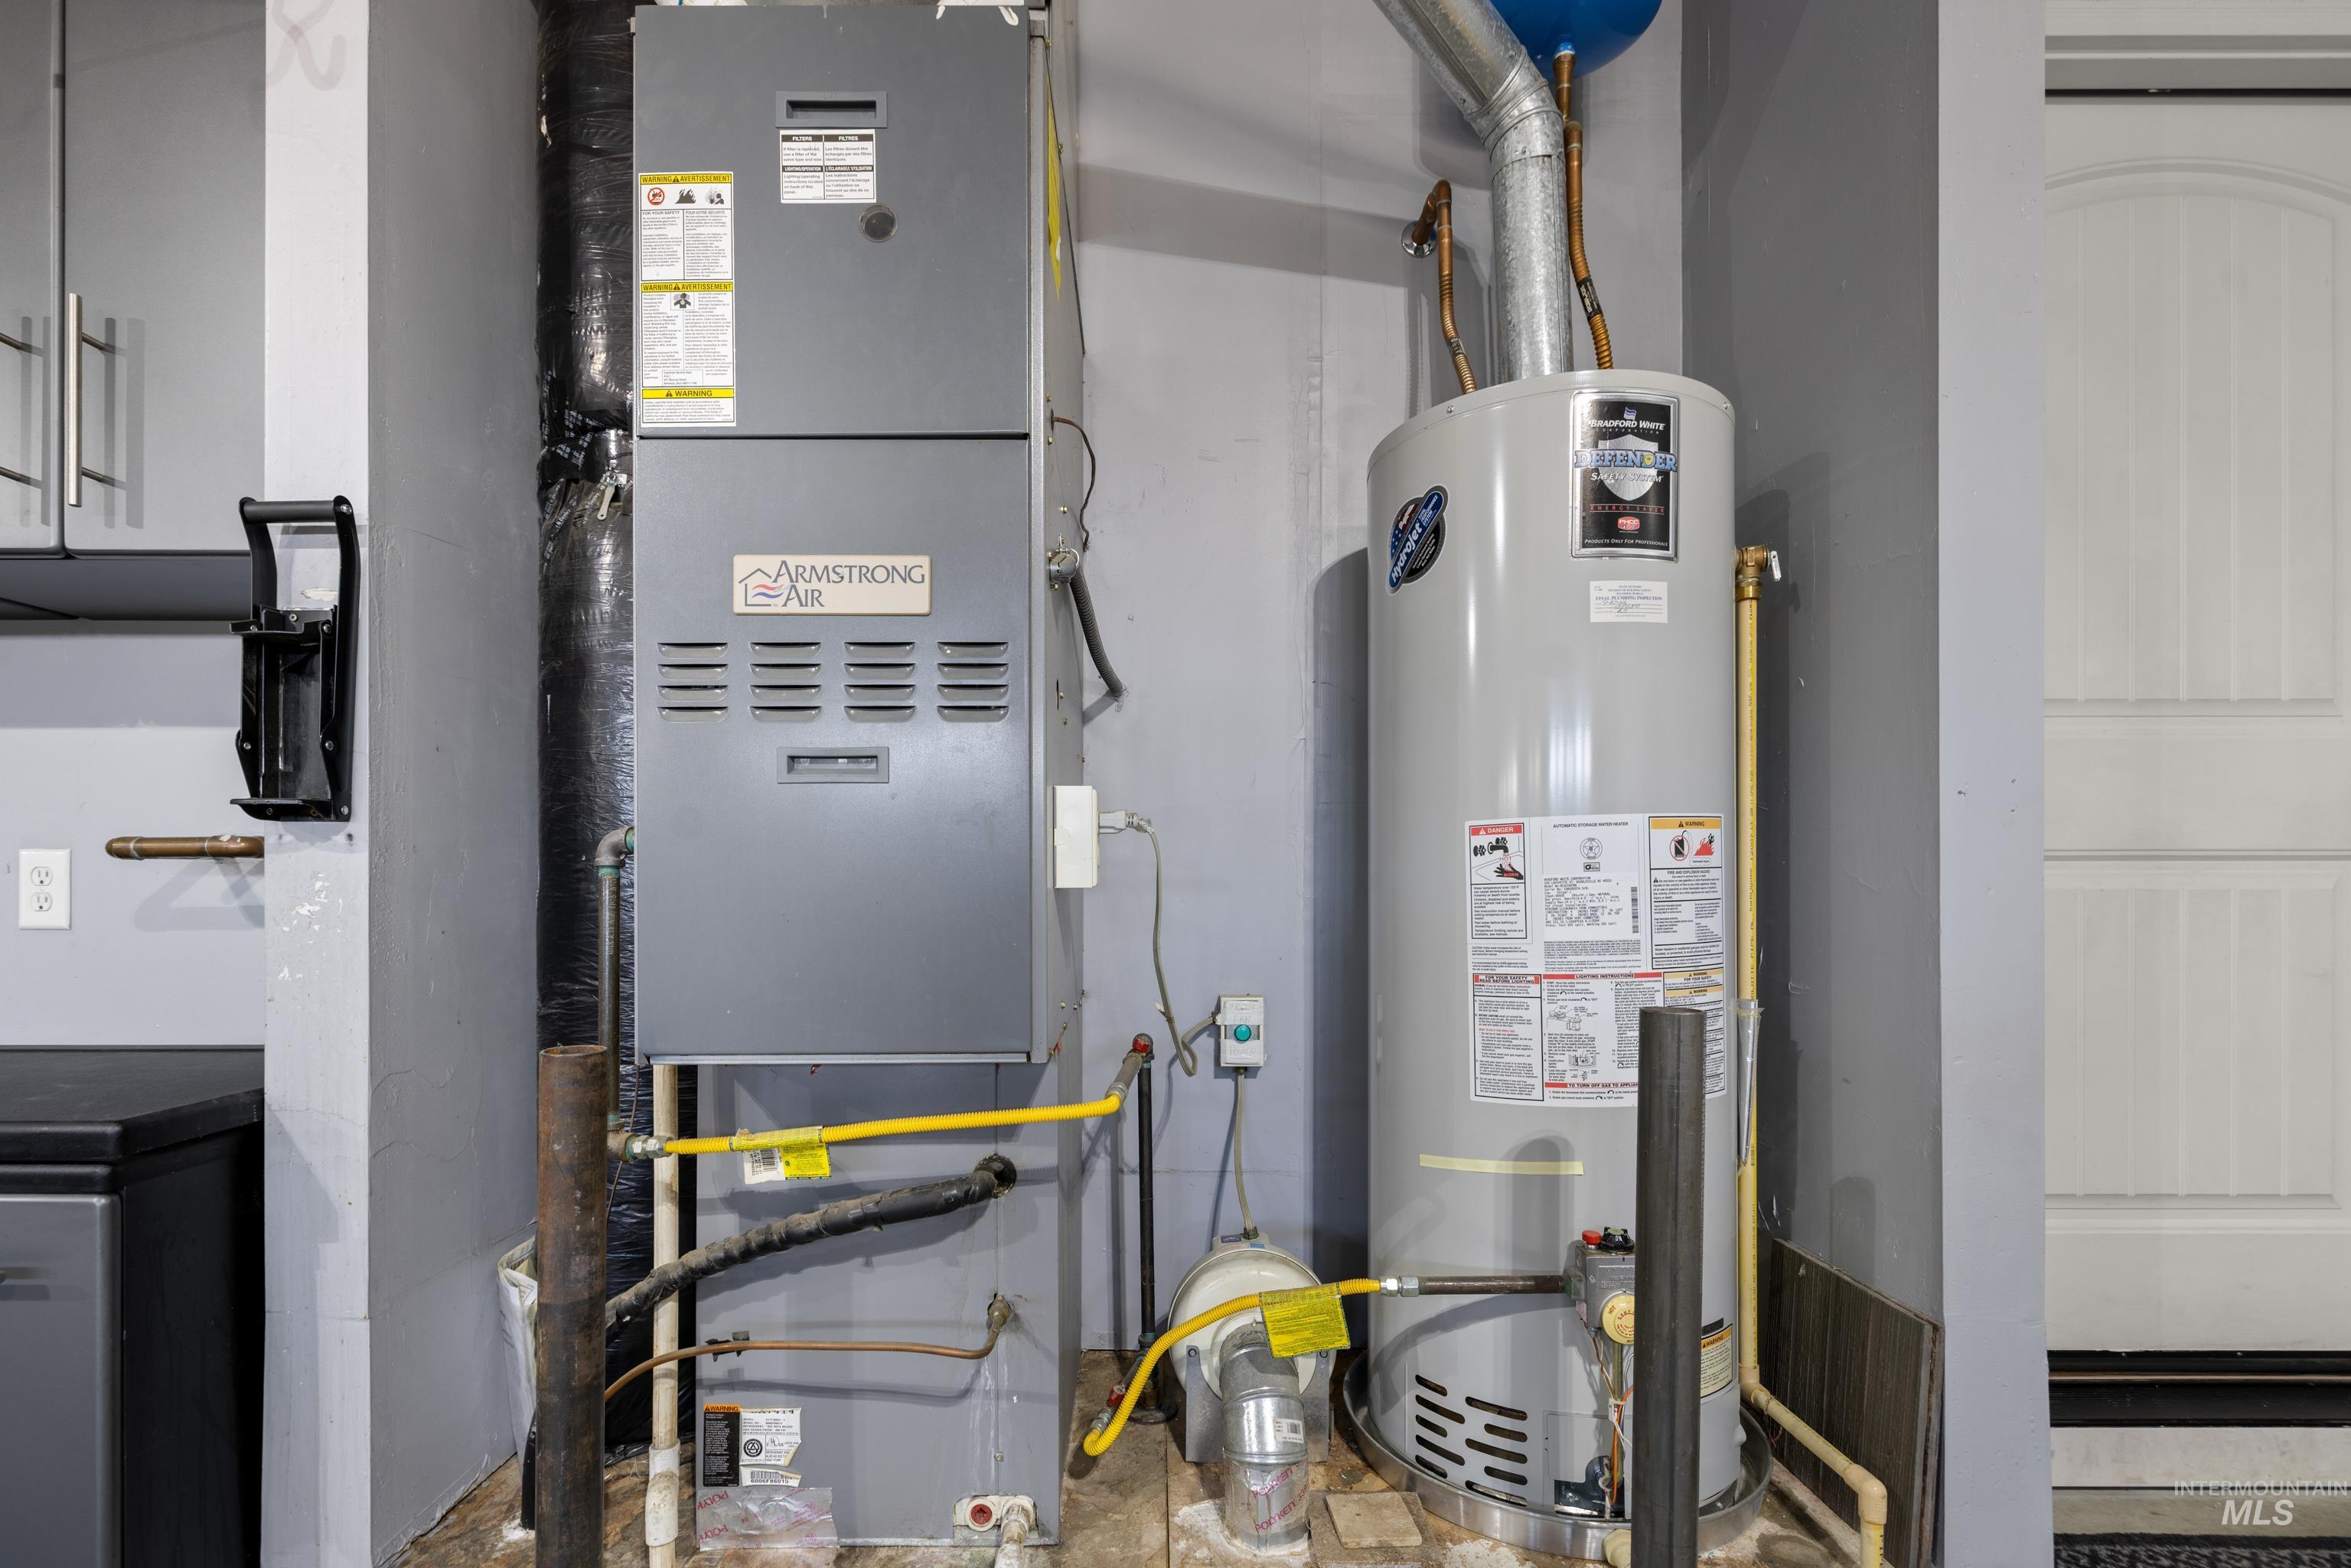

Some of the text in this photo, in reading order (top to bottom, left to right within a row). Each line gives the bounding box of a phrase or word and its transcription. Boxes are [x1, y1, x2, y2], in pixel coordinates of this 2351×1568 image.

[1639, 421, 1664, 430] WHITE
[1574, 449, 1677, 472] DEFENDER
[1628, 474, 1662, 482] SYSTEM
[1421, 494, 1439, 522] PERFORMANCE
[1422, 510, 1433, 526] SYSTEM
[1391, 521, 1423, 584] Hydrojet
[772, 560, 925, 584] ARMSTRONG
[781, 584, 825, 607] AIR
[1608, 1305, 1616, 1315] HOT
[1706, 1334, 1723, 1346] WARNING
[1252, 1467, 1293, 1498] POLYKEN
[1255, 1501, 1296, 1530] POLYKEN
